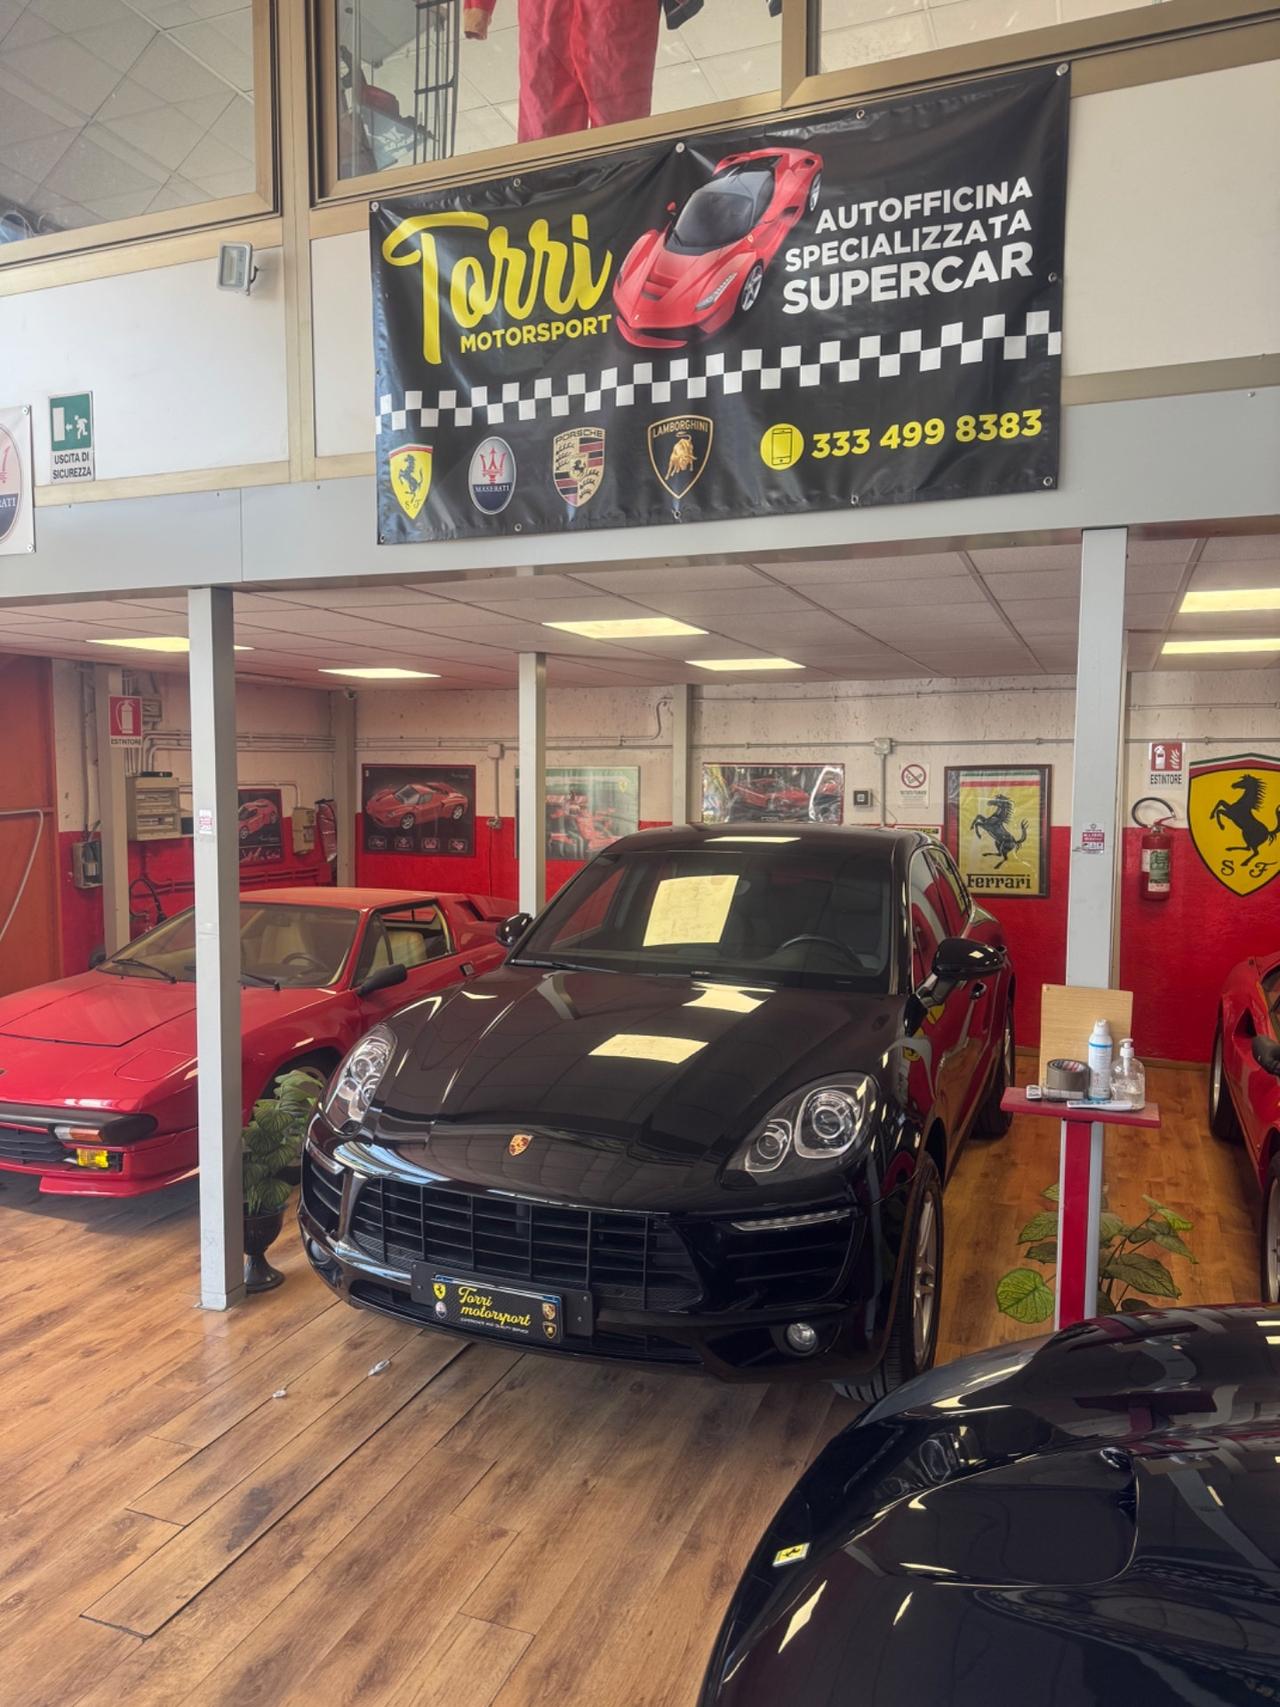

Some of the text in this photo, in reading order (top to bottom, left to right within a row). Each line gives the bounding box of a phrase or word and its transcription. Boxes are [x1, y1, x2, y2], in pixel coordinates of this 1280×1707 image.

[814, 176, 1033, 234] AUTOFFICINA
[784, 208, 1032, 273] SPECIALIZZATA
[382, 211, 613, 365] Torri
[782, 241, 1034, 315] SUPERCAR
[460, 314, 612, 353] MOTORSPORT
[555, 427, 605, 444] PORSCHE
[652, 418, 709, 438] LAMBORGHINI
[811, 408, 1042, 459] 333 499 8383
[54, 452, 90, 465] USCITA DI
[52, 466, 92, 479] SICUREZZA
[475, 484, 510, 493] MASERATI
[111, 738, 142, 746] ESTINTORE
[1150, 773, 1182, 785] ESTINTORE
[966, 873, 1032, 889] Ferrari
[458, 1286, 493, 1307] Torri
[460, 1305, 532, 1327] motorsport
